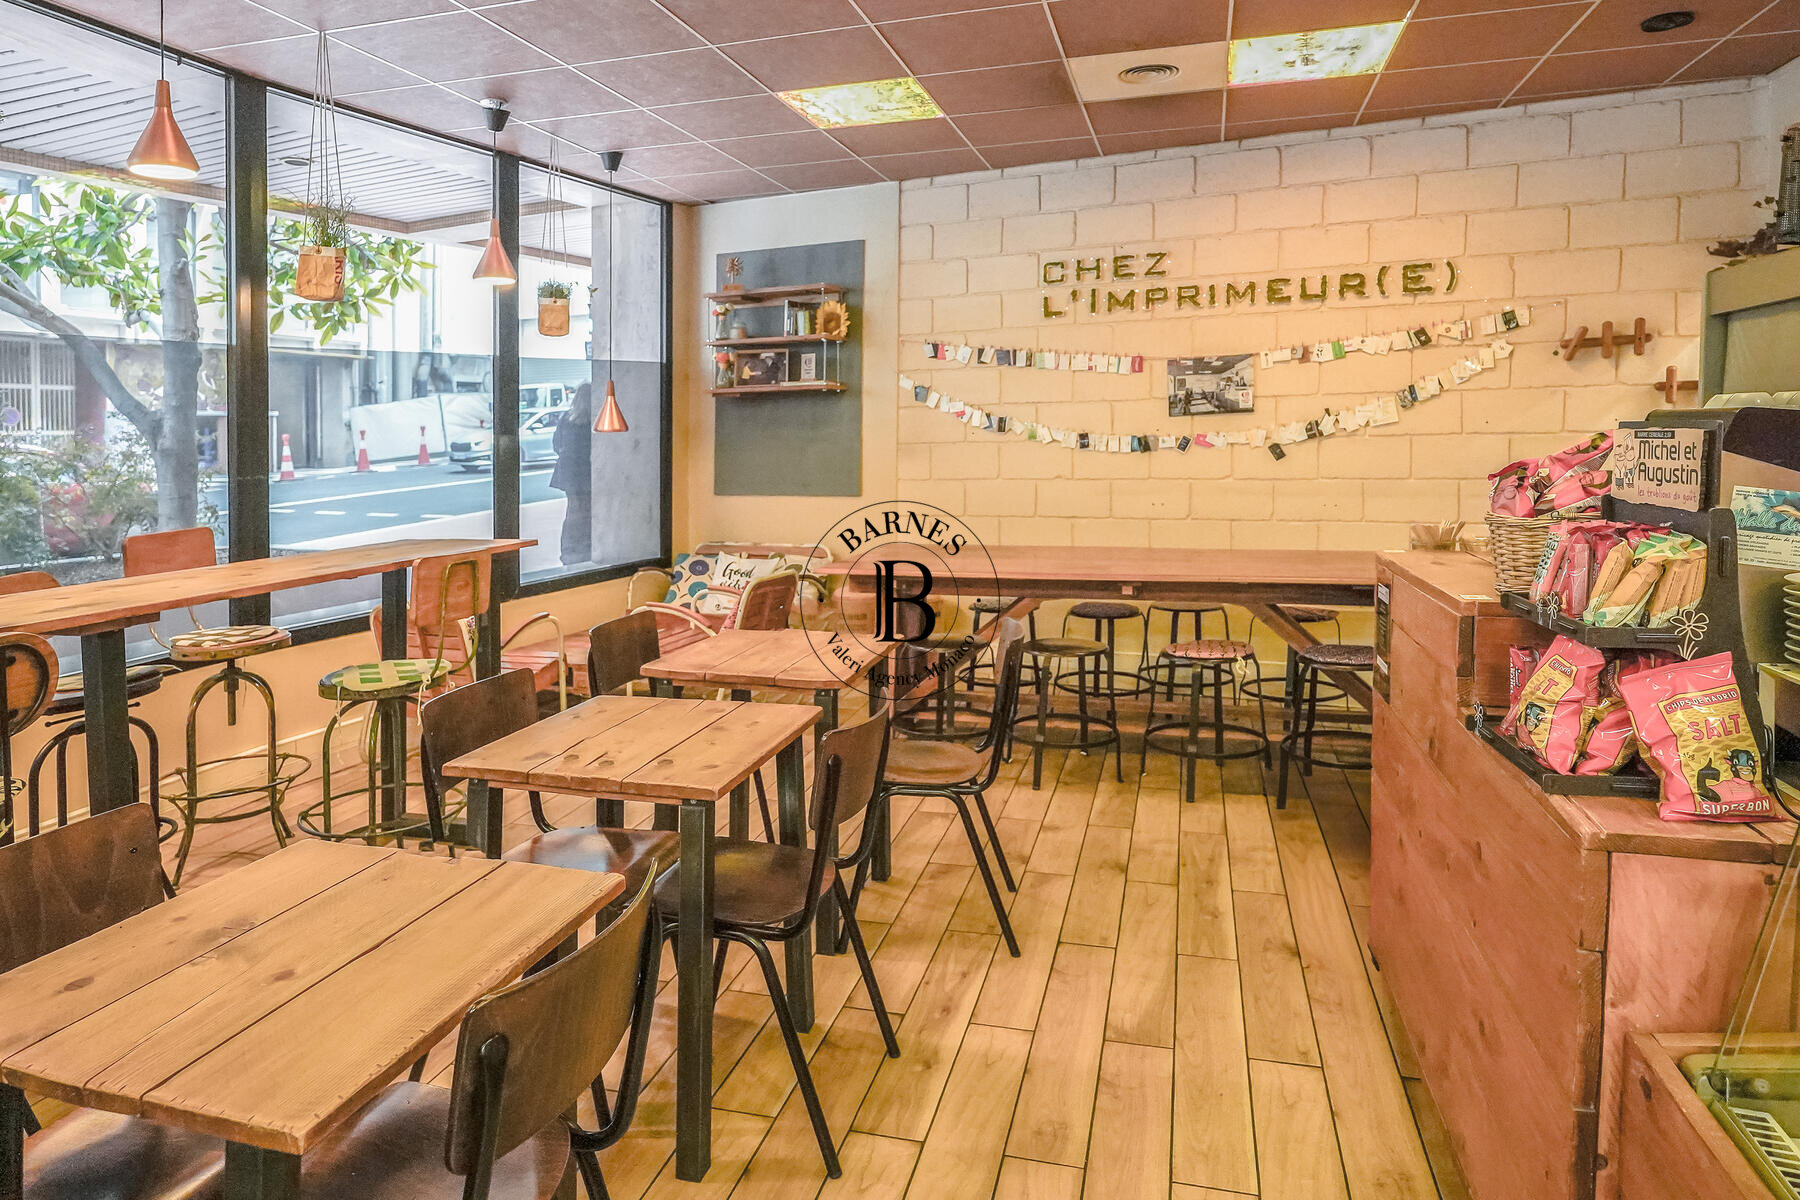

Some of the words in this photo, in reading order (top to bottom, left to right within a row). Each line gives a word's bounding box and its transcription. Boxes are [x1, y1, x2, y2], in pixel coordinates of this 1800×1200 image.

[1043, 252, 1168, 285] CHEZ
[1042, 259, 1457, 317] L'IMPRIMEUR(E)
[1638, 440, 1681, 461] Michel
[1684, 442, 1697, 460] et
[1638, 462, 1698, 486] Augustin
[722, 561, 756, 580] Good
[1666, 699, 1691, 712] CHIPS
[1693, 697, 1703, 705] DE
[1704, 690, 1738, 704] MADRID
[1688, 714, 1741, 741] SALT
[1702, 799, 1770, 815] SUPERBON
